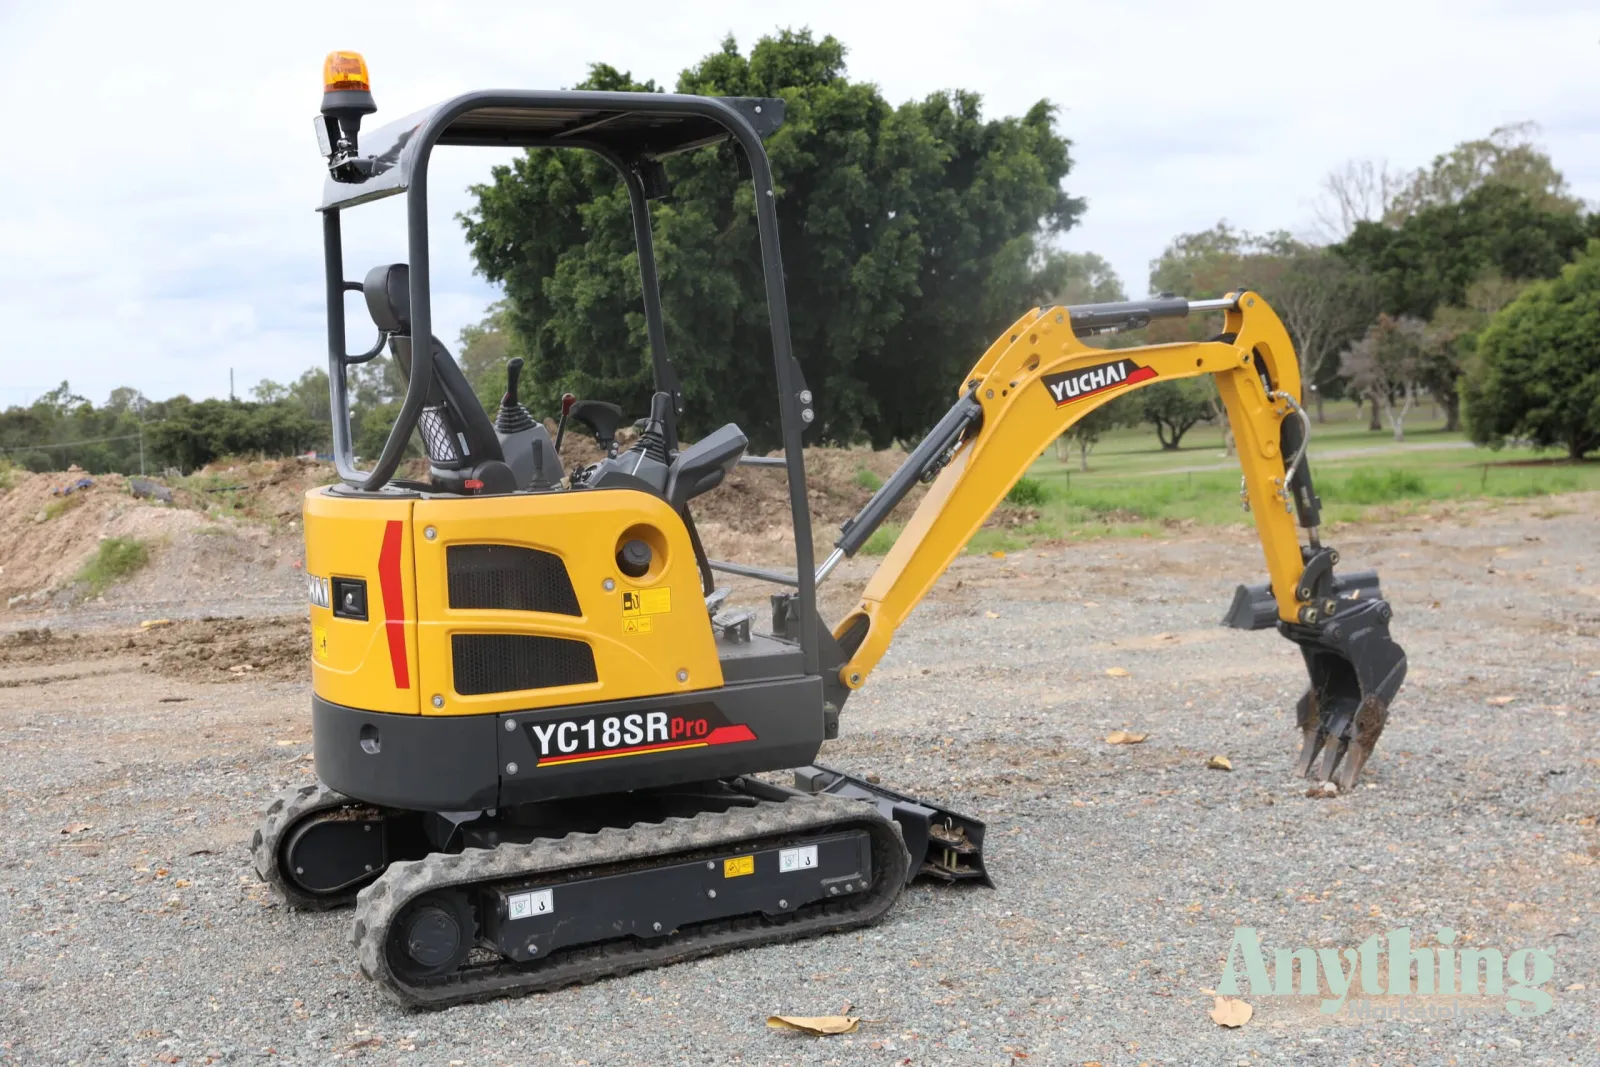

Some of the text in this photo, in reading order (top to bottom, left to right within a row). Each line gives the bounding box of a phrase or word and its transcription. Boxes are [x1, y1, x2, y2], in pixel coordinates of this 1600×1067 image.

[1050, 362, 1127, 401] YUCHAI
[532, 712, 708, 755] YC18SR Pro
